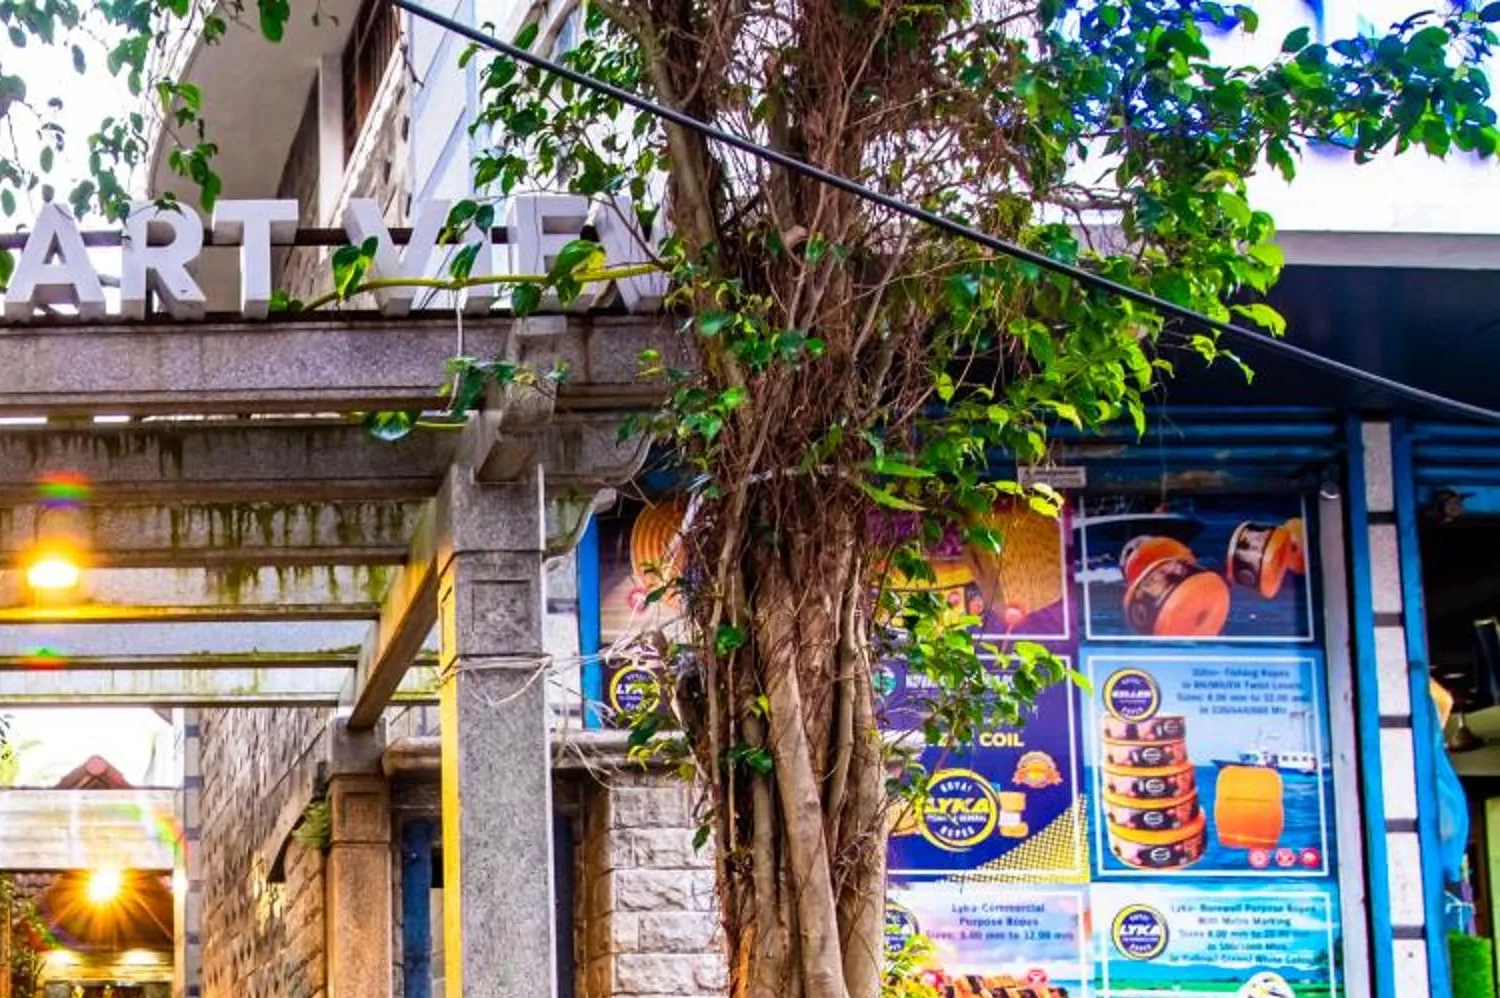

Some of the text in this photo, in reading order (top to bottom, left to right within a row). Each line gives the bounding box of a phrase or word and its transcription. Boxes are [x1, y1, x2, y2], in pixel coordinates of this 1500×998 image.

[980, 732, 1025, 747] COIL
[923, 797, 990, 814] LYKA
[959, 916, 1003, 927] Purpose
[1119, 923, 1161, 937] LYKA
